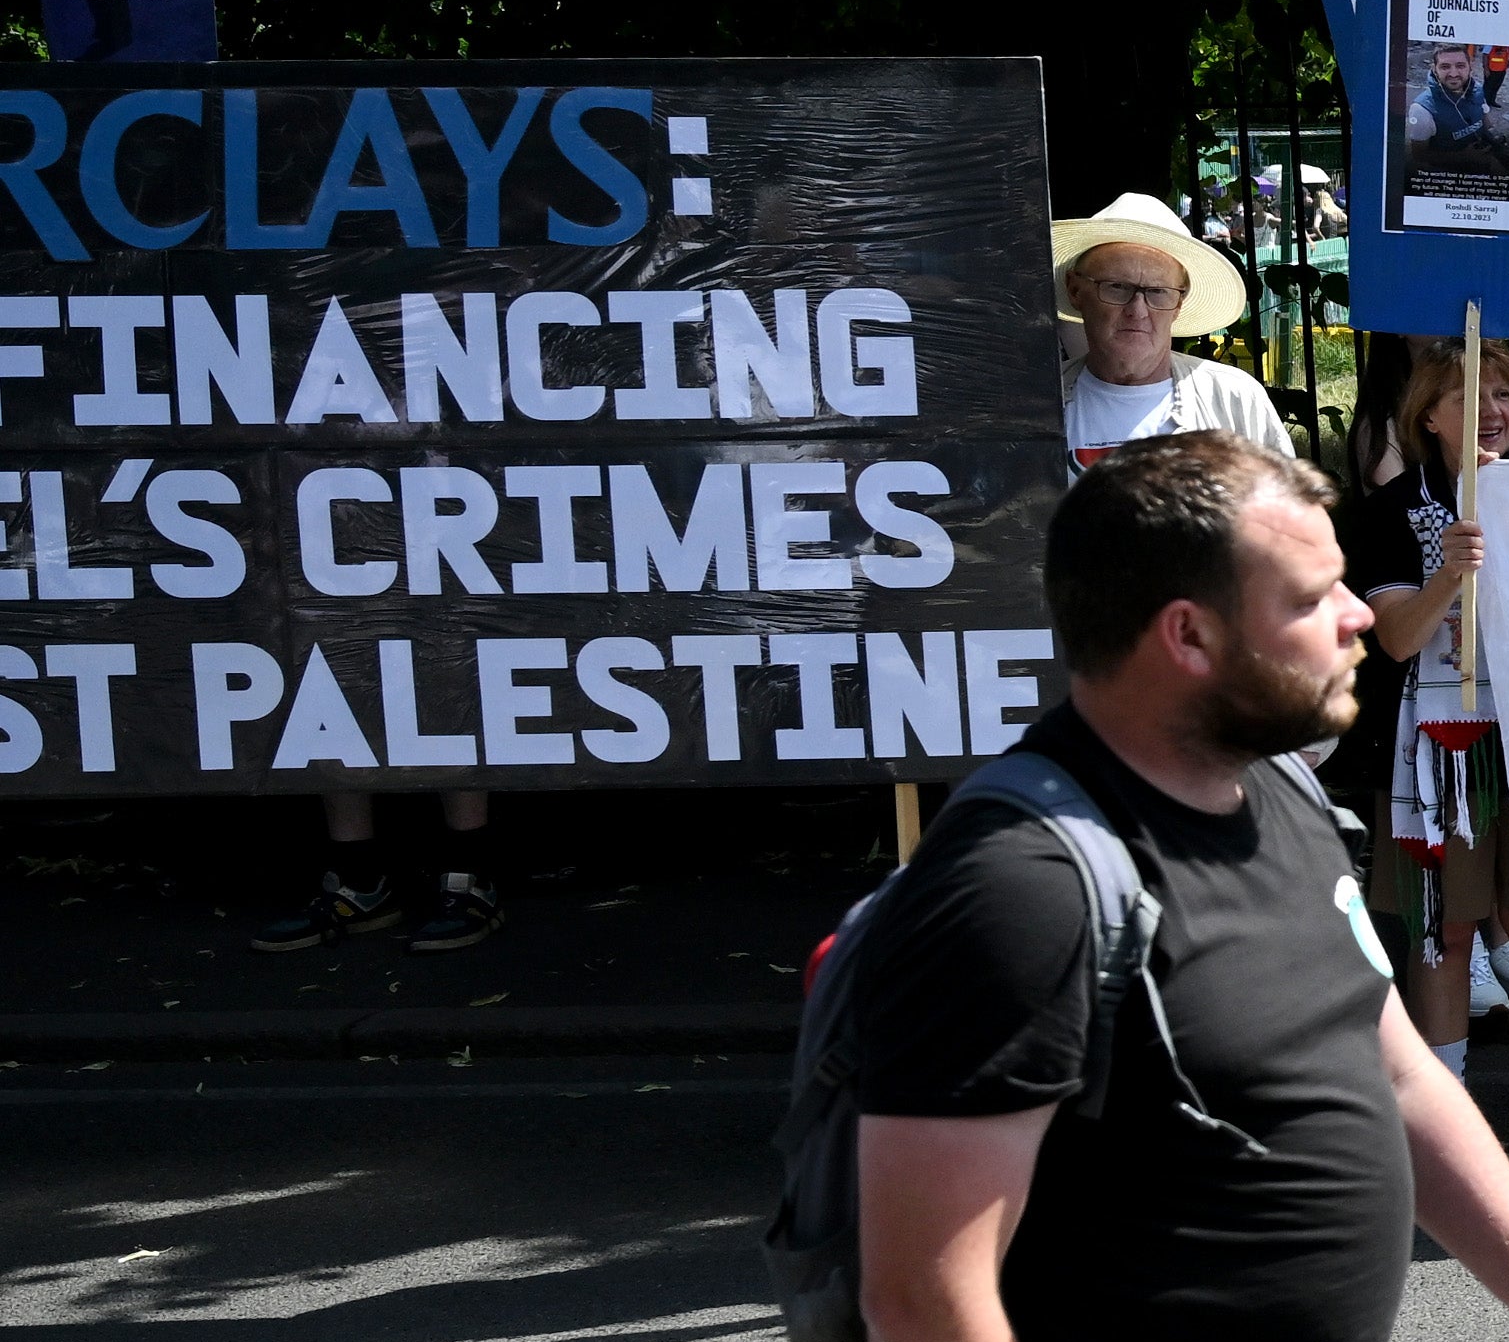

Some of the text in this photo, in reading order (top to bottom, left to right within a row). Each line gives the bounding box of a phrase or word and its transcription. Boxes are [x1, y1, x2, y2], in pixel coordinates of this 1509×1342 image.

[1427, 10, 1441, 23] OF
[1427, 24, 1455, 38] GAZA
[296, 459, 955, 597] CRIMES
[192, 627, 1055, 772] PALESTINE
